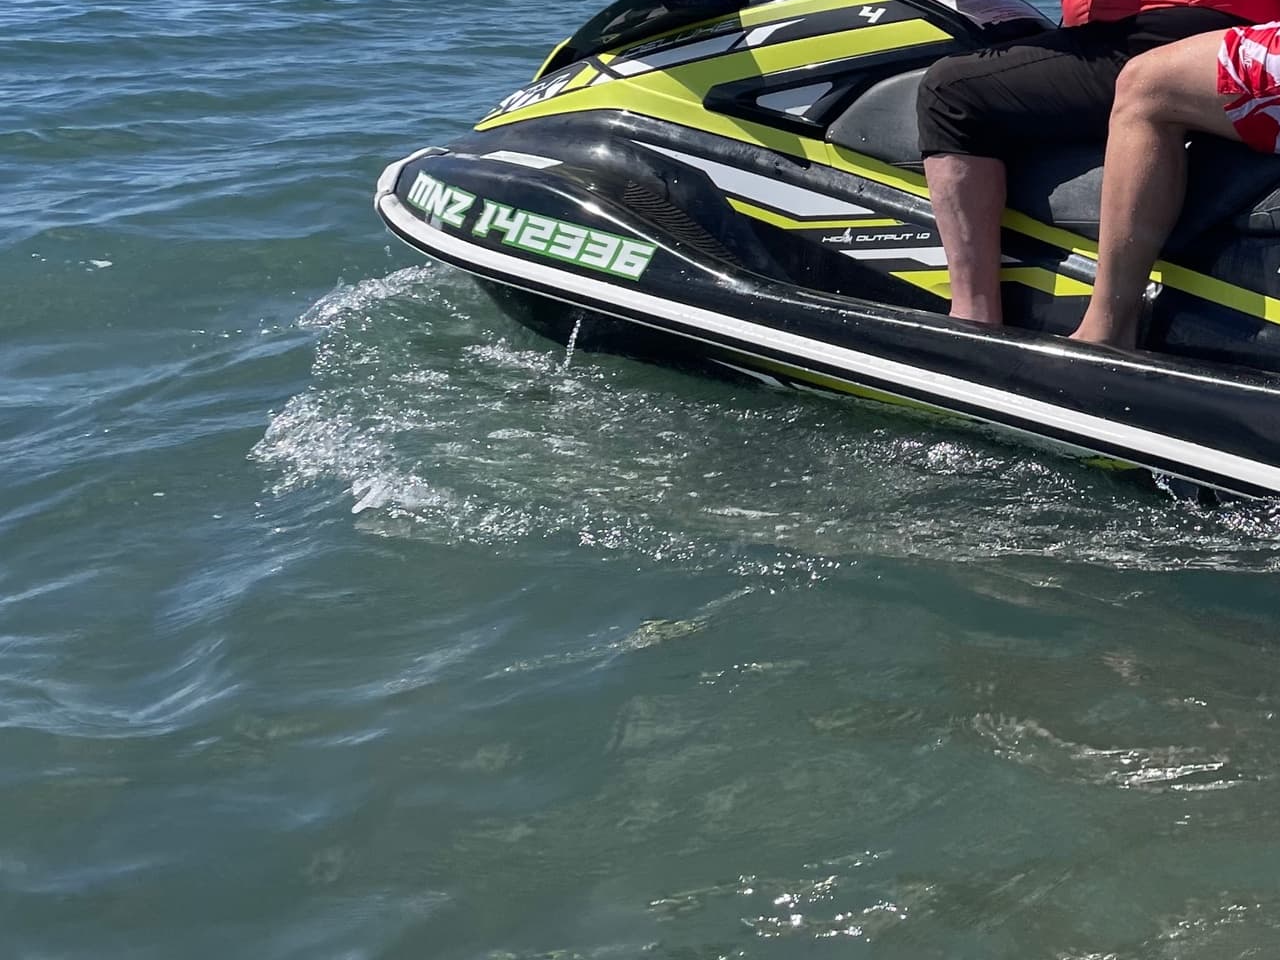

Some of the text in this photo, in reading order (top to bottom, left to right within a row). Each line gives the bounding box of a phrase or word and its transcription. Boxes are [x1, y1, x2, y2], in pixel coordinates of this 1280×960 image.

[858, 6, 885, 23] 4
[407, 170, 660, 282] MNZ 142336
[856, 233, 914, 242] OUTPUT
